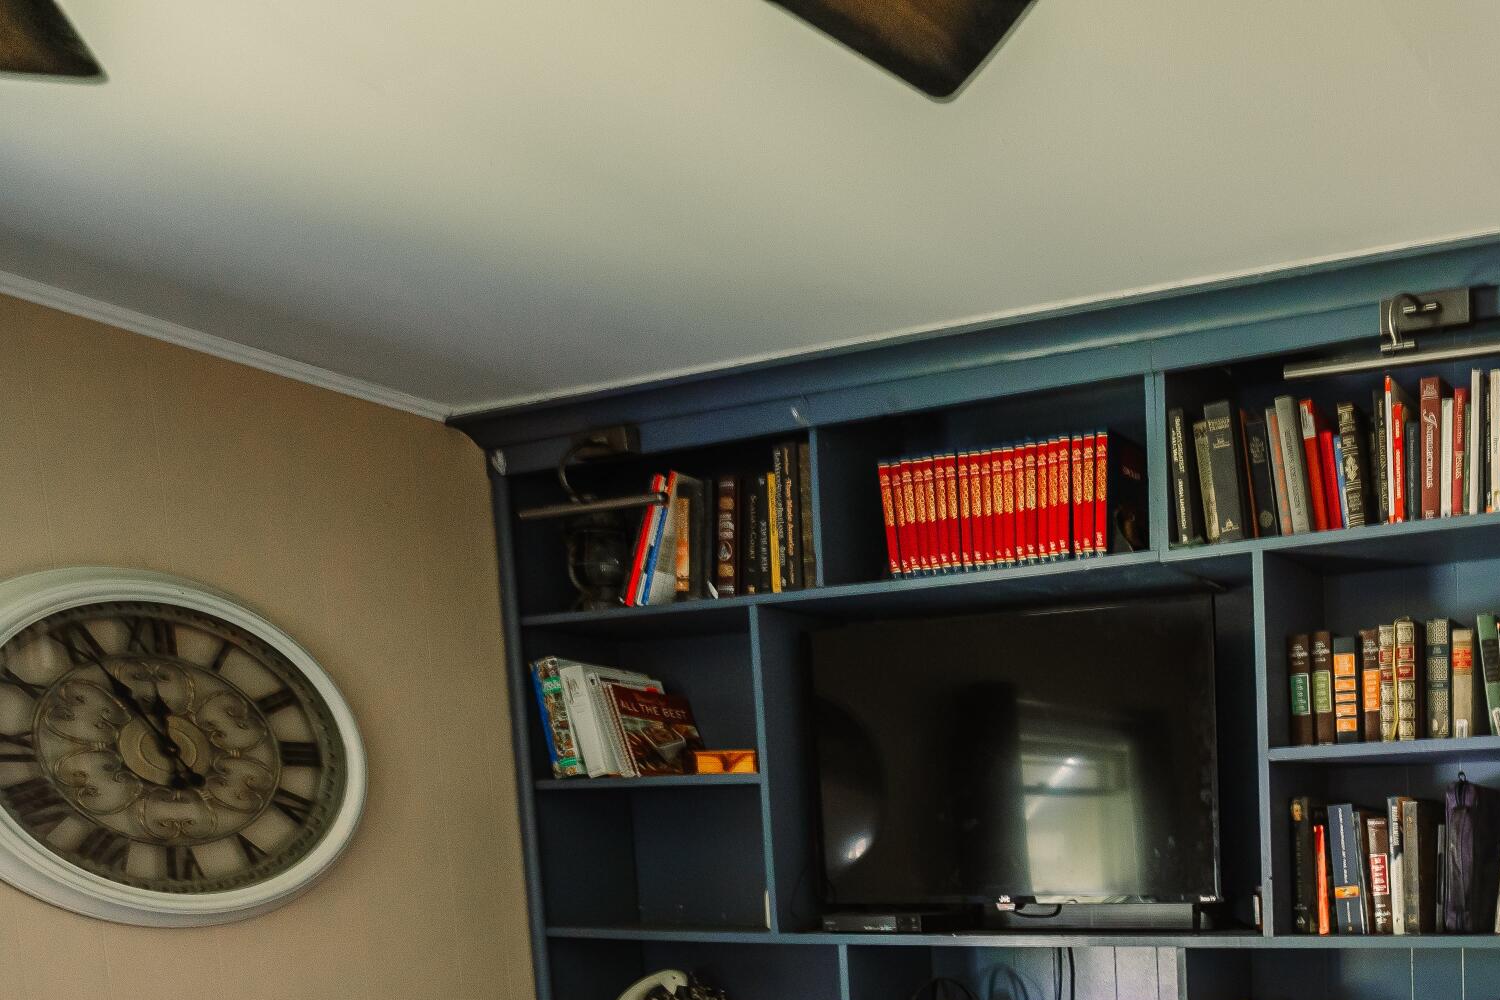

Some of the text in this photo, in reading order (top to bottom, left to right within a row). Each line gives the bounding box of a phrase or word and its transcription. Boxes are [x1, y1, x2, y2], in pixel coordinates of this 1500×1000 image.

[1379, 428, 1388, 470] RELIGION
[620, 700, 687, 720] ALL THE BEST
